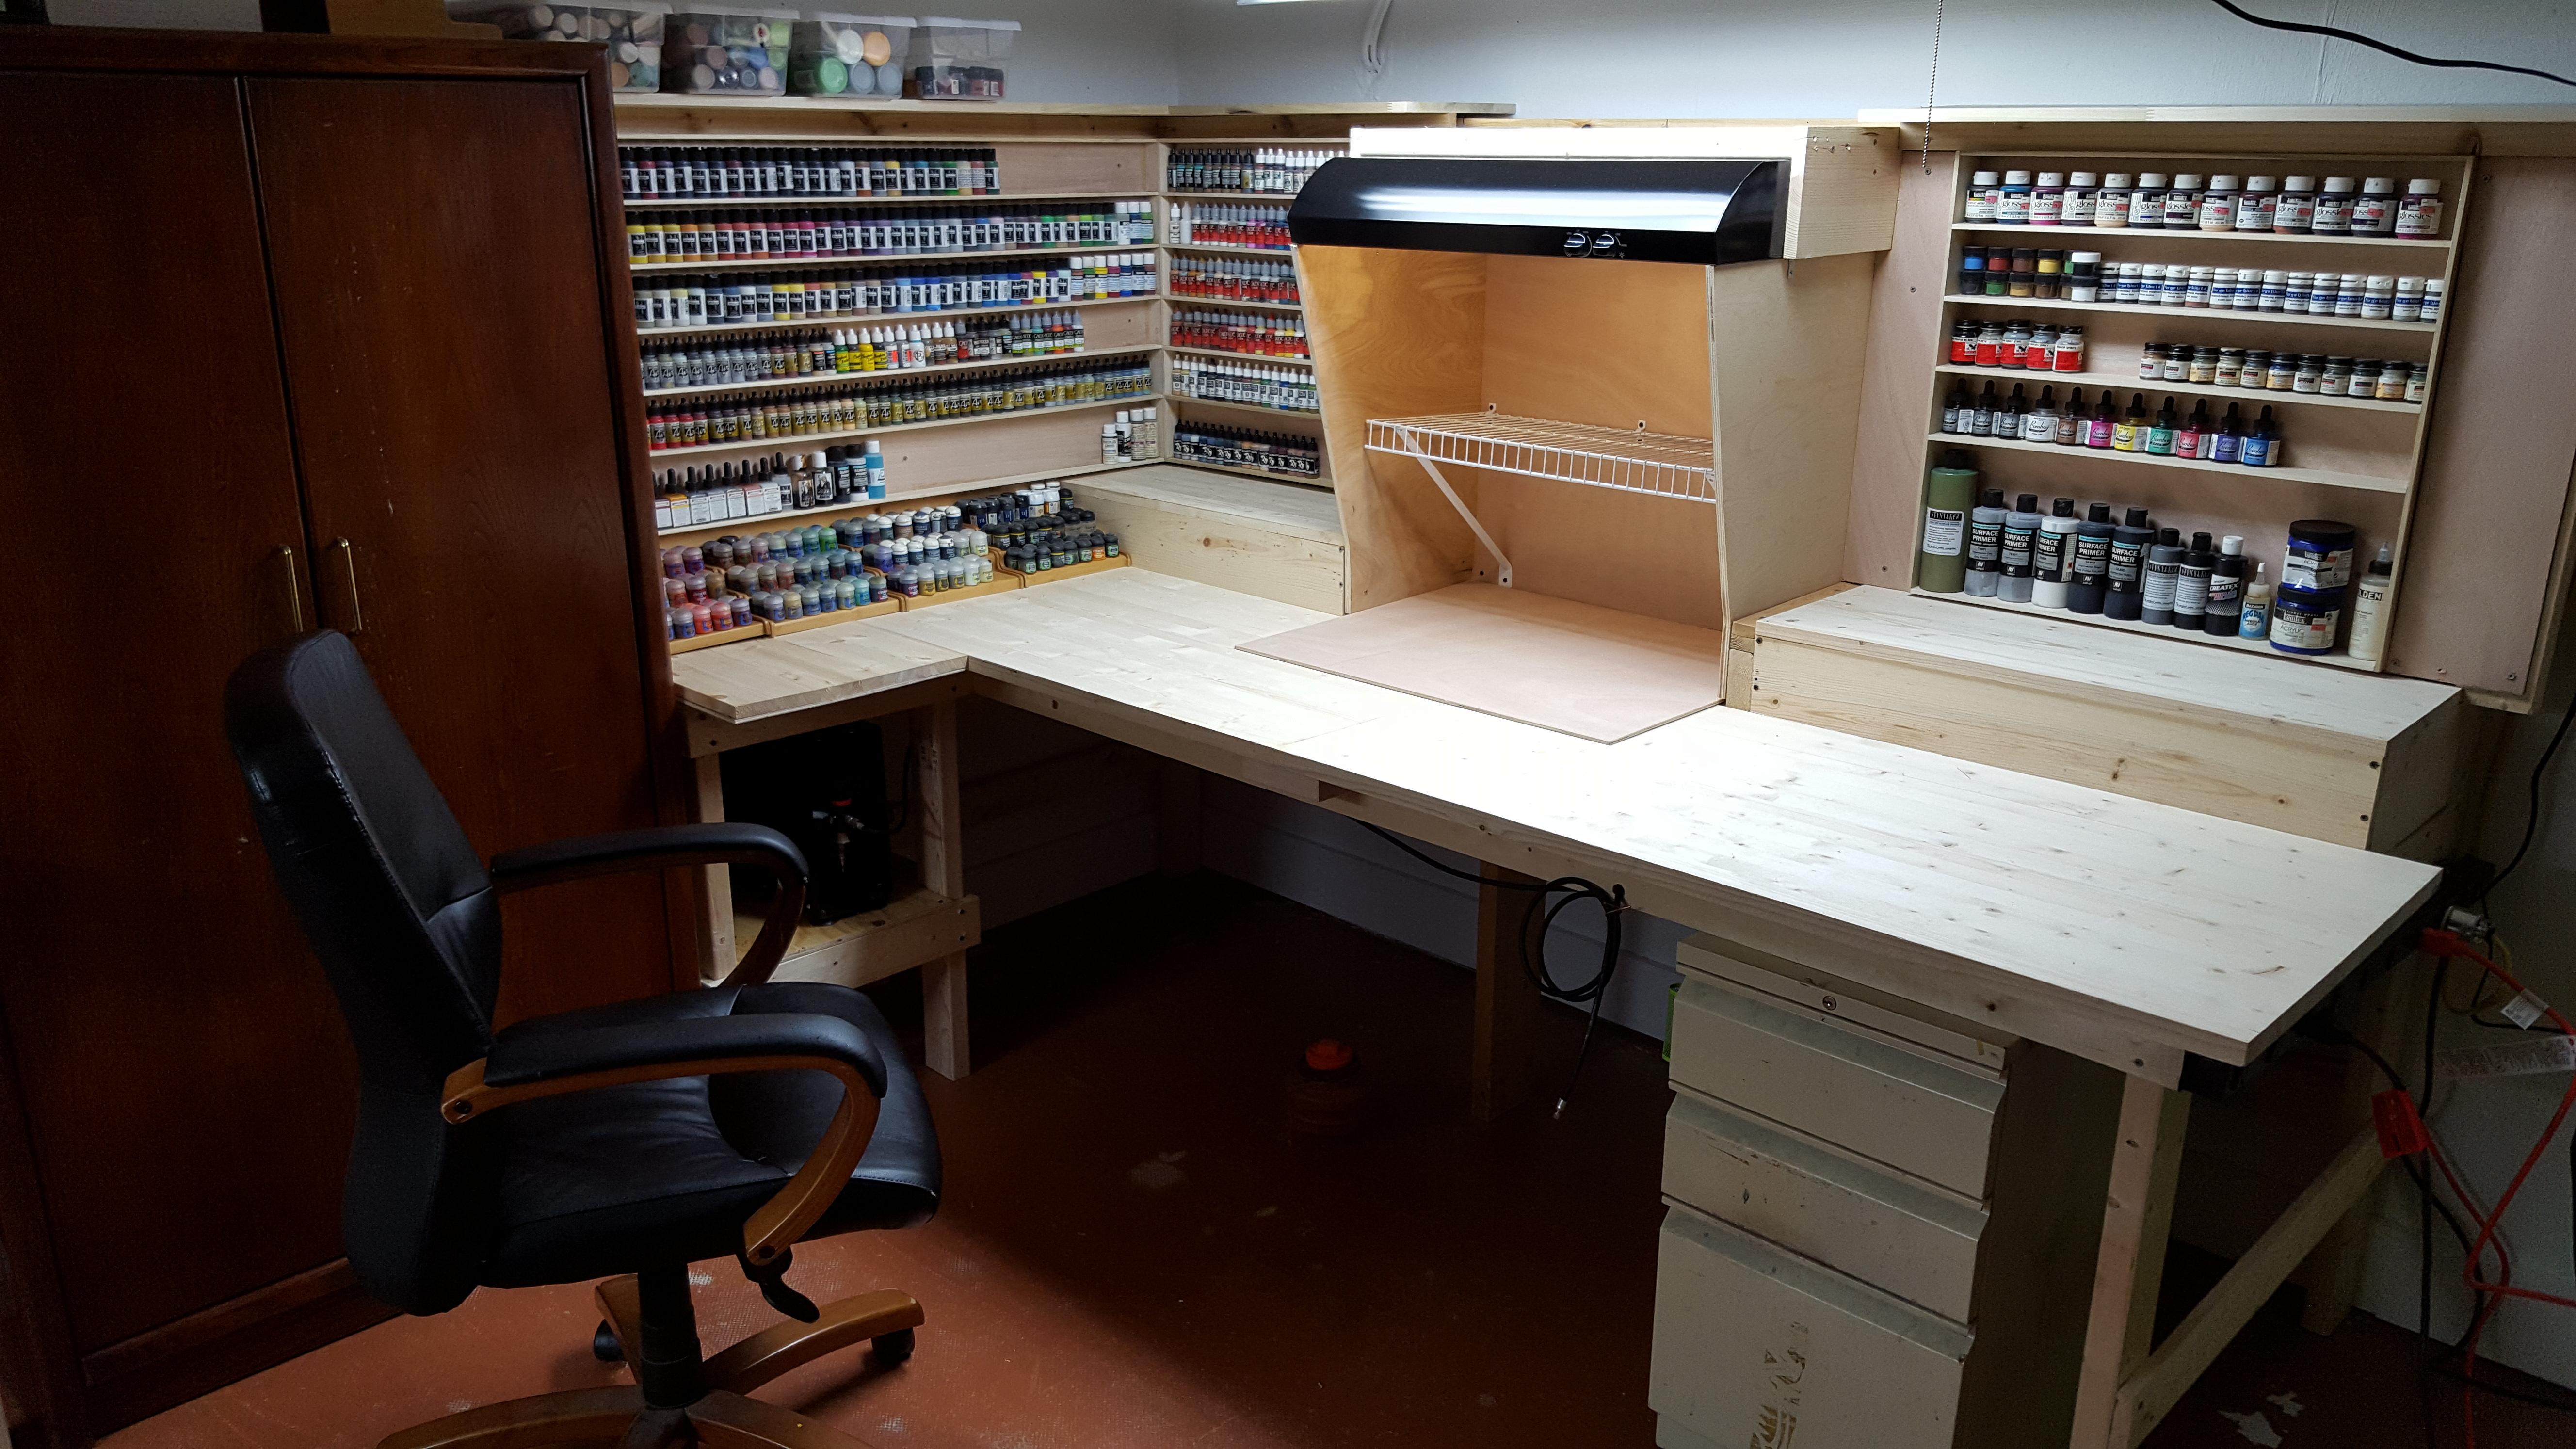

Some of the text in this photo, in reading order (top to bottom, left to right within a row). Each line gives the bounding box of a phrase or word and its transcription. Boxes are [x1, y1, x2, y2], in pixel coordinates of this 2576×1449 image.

[2004, 533, 2030, 542] SURFACE
[2078, 541, 2108, 549] SURFACE
[2112, 547, 2138, 556] SURFACE
[2112, 553, 2135, 563] PRIMER
[2359, 590, 2382, 600] LDEN
